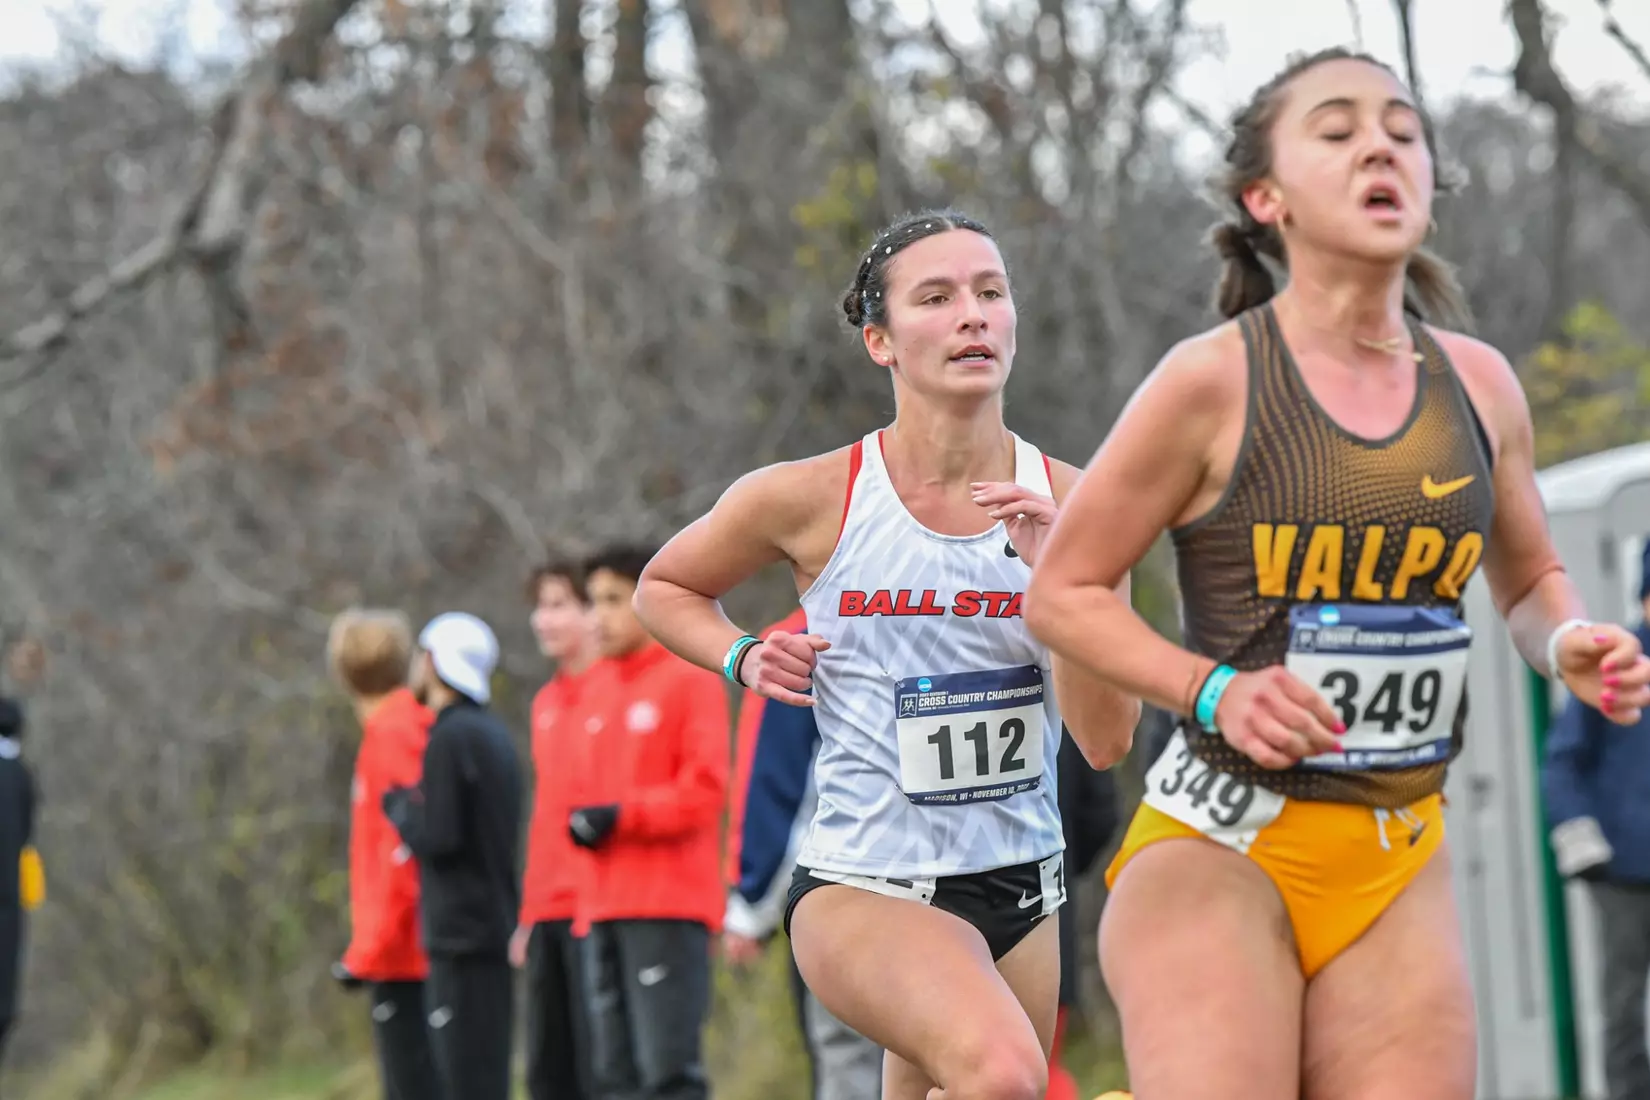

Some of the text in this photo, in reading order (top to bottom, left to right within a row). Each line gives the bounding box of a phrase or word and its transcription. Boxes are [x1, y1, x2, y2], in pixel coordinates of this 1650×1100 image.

[1252, 523, 1483, 601] VALPO
[838, 589, 945, 617] BALL
[918, 695, 946, 708] CROSS
[947, 691, 984, 705] COUNTRY
[986, 683, 1043, 701] CHAMPIONSHIPS
[1320, 668, 1441, 734] 349
[927, 717, 1026, 780] 112
[959, 792, 968, 801] WI
[972, 787, 1007, 800] NOVEMBER
[1160, 748, 1255, 827] 349
